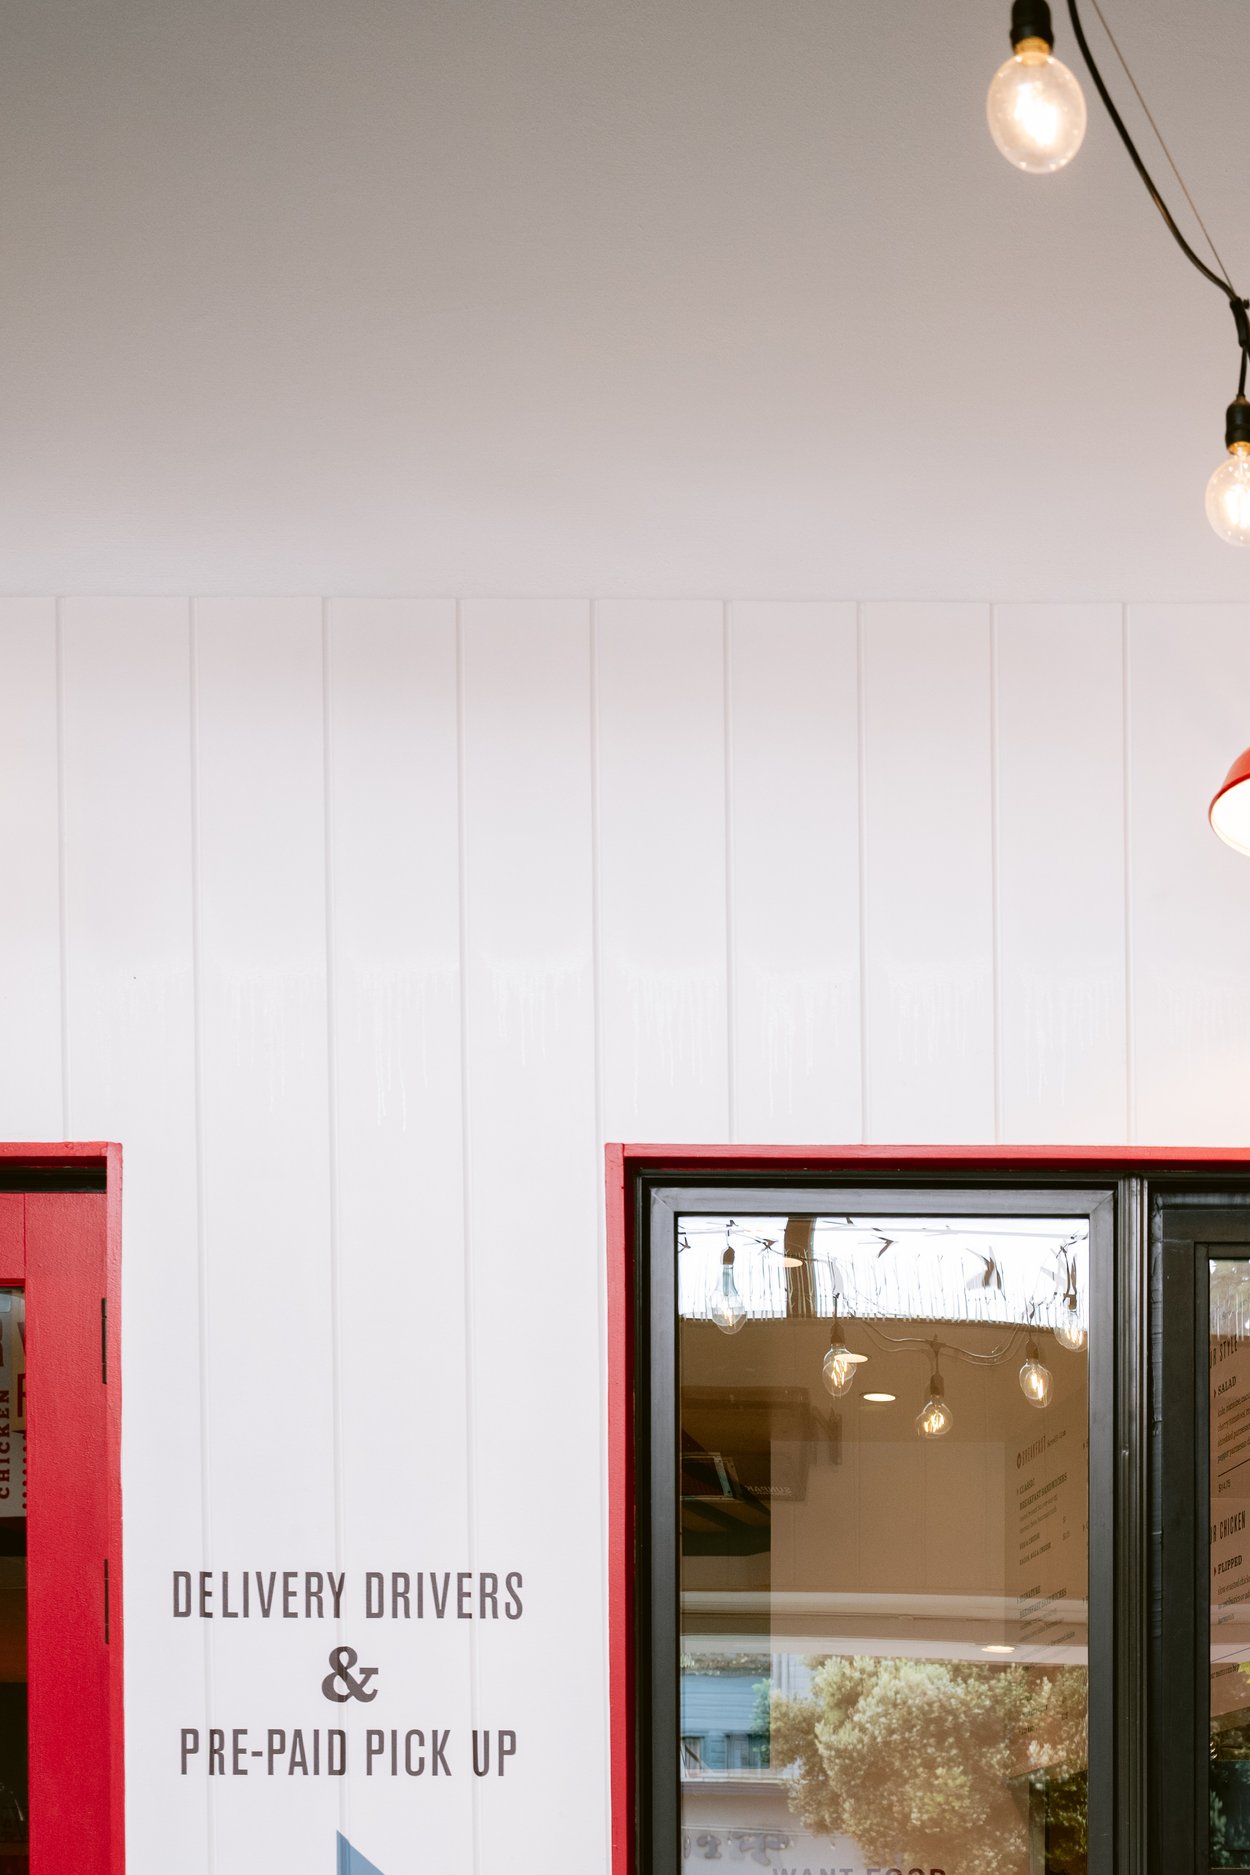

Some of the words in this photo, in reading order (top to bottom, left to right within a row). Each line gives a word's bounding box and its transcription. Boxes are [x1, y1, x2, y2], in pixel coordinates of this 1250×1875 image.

[1220, 1334, 1238, 1362] STYLE
[1217, 1376, 1237, 1396] SALAD
[0, 1389, 10, 1499] CHICKEN
[1022, 1434, 1046, 1466] BREAKFAST
[1220, 1510, 1246, 1540] CHICKEN
[1217, 1554, 1243, 1575] FLIPPED
[172, 1570, 346, 1618] DELIVERY
[366, 1572, 524, 1620] DRIVERS
[321, 1646, 380, 1703] &
[180, 1728, 346, 1776] PRE-PAID
[366, 1728, 452, 1777] PICK
[472, 1729, 517, 1778] UP
